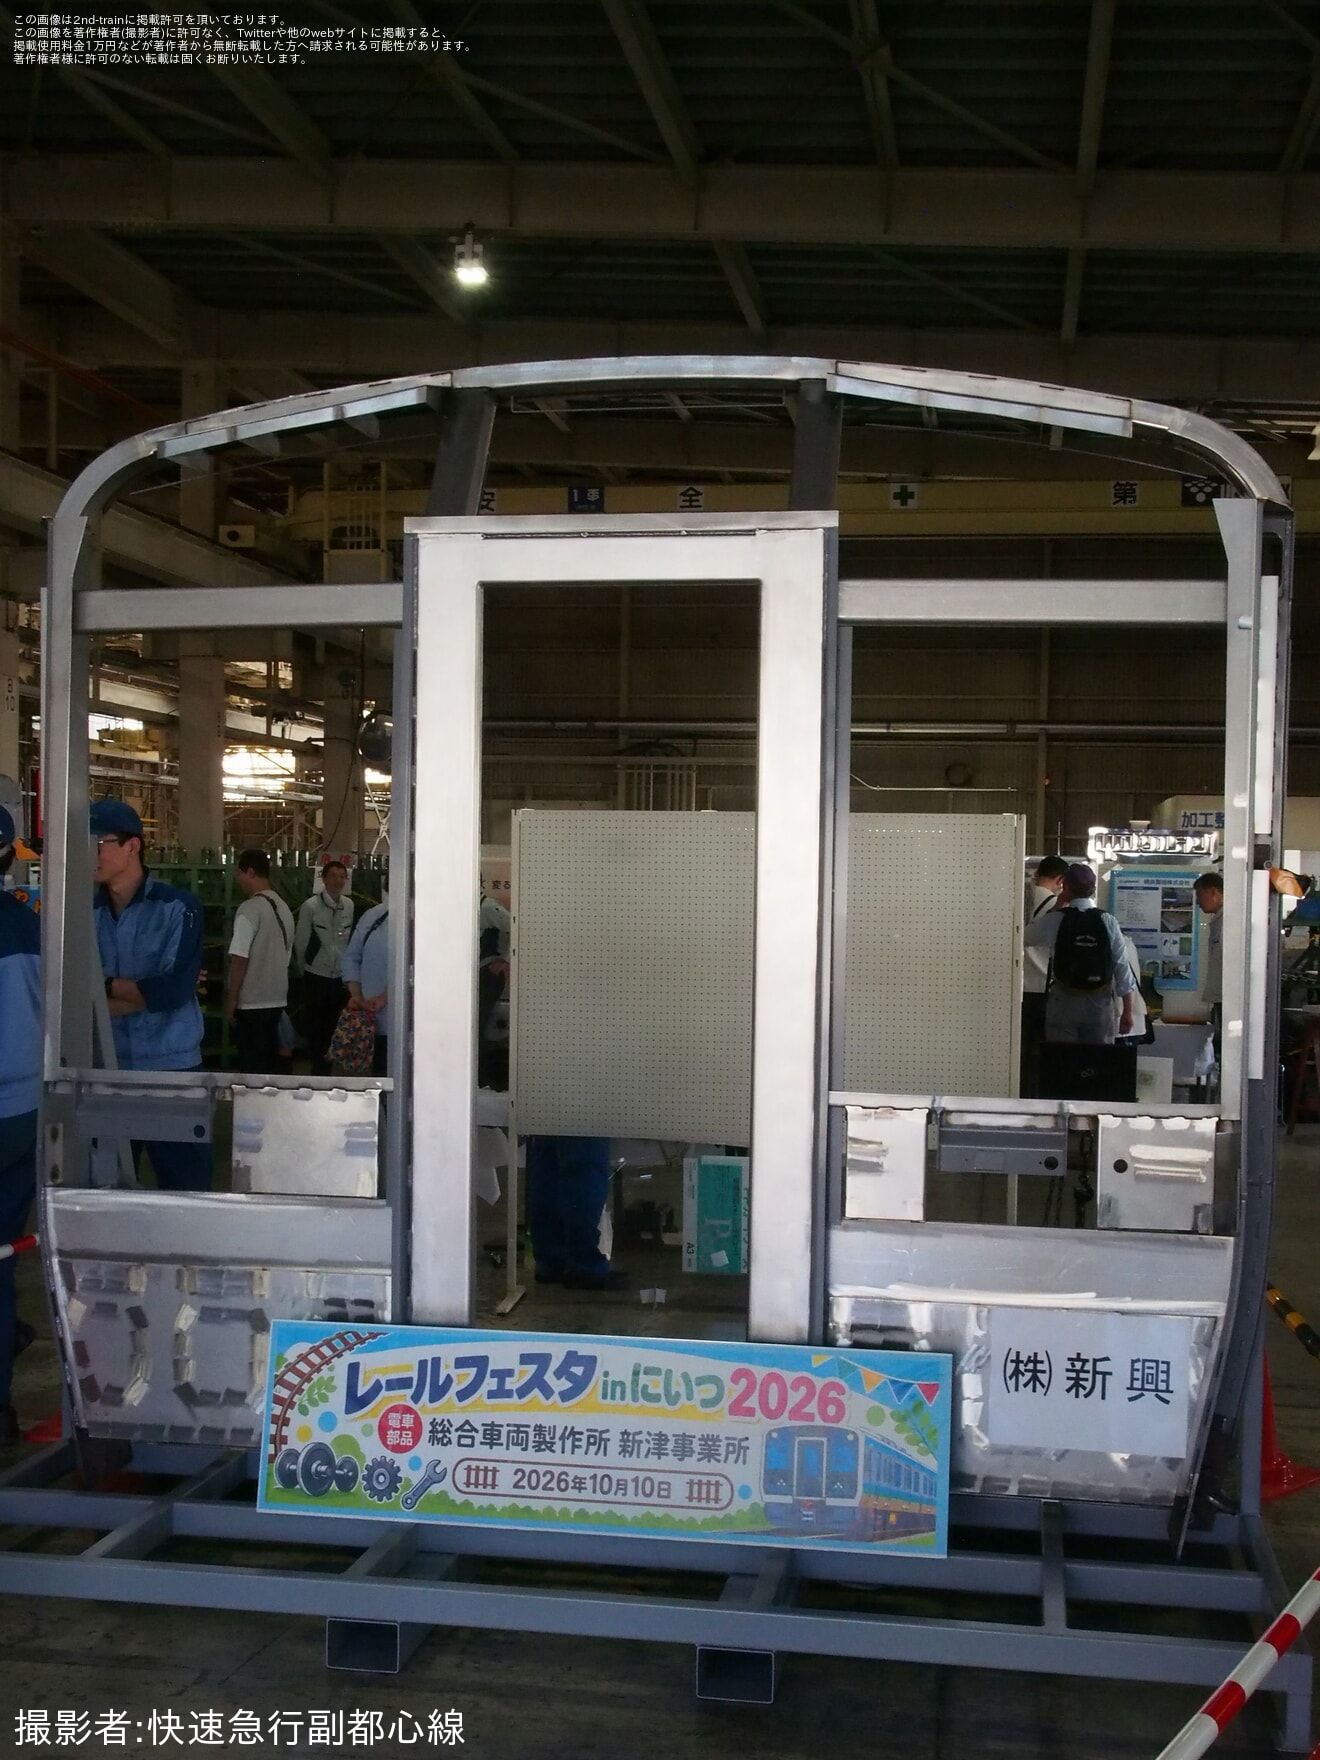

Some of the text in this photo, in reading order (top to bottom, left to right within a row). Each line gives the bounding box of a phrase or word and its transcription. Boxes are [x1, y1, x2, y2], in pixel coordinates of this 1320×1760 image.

[679, 486, 703, 509] 全
[1112, 480, 1138, 506] 第
[387, 1412, 415, 1428] 電車
[386, 1429, 414, 1446] 部品
[428, 1417, 750, 1465] 総合車両製作所 新津事業所
[512, 1467, 672, 1499] 2026年10月10日
